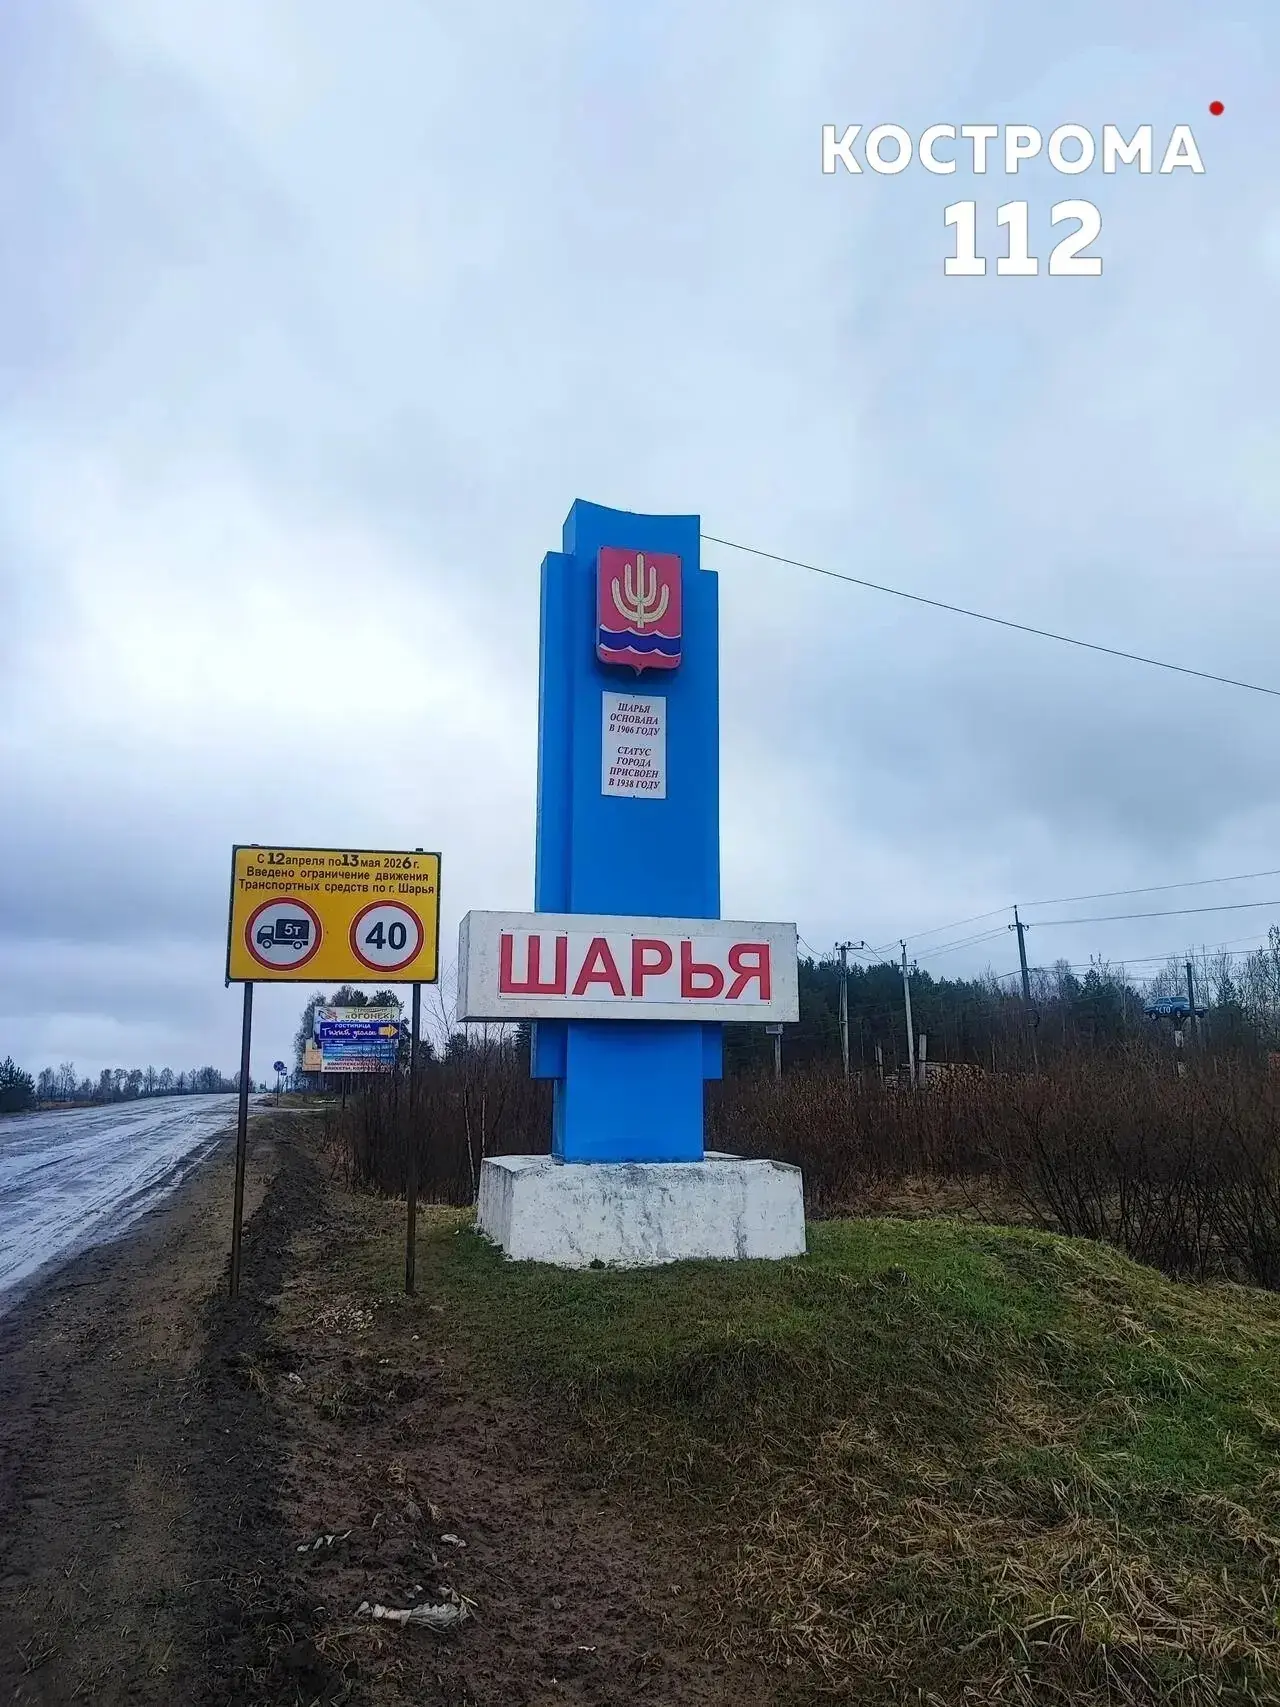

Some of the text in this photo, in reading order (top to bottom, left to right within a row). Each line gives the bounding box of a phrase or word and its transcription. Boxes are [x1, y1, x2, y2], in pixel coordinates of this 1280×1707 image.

[618, 702, 651, 714] ШАРЬЯ
[610, 713, 658, 725] ОСНОВАНА
[609, 724, 660, 737] В 1906 ГОДУ
[617, 746, 652, 757] СТАТУС
[616, 756, 651, 768] ГОРОДА
[609, 767, 659, 779] ПРИСВОЕН
[608, 778, 660, 791] В 1938 ГОДУ
[257, 853, 265, 864] С
[383, 857, 412, 869] 2026
[246, 866, 429, 882] Введено ограничение движения
[239, 879, 434, 896] Транспортных средств по г. Шарья
[365, 921, 407, 950] 40
[499, 933, 771, 1000] ШАРЬЯ
